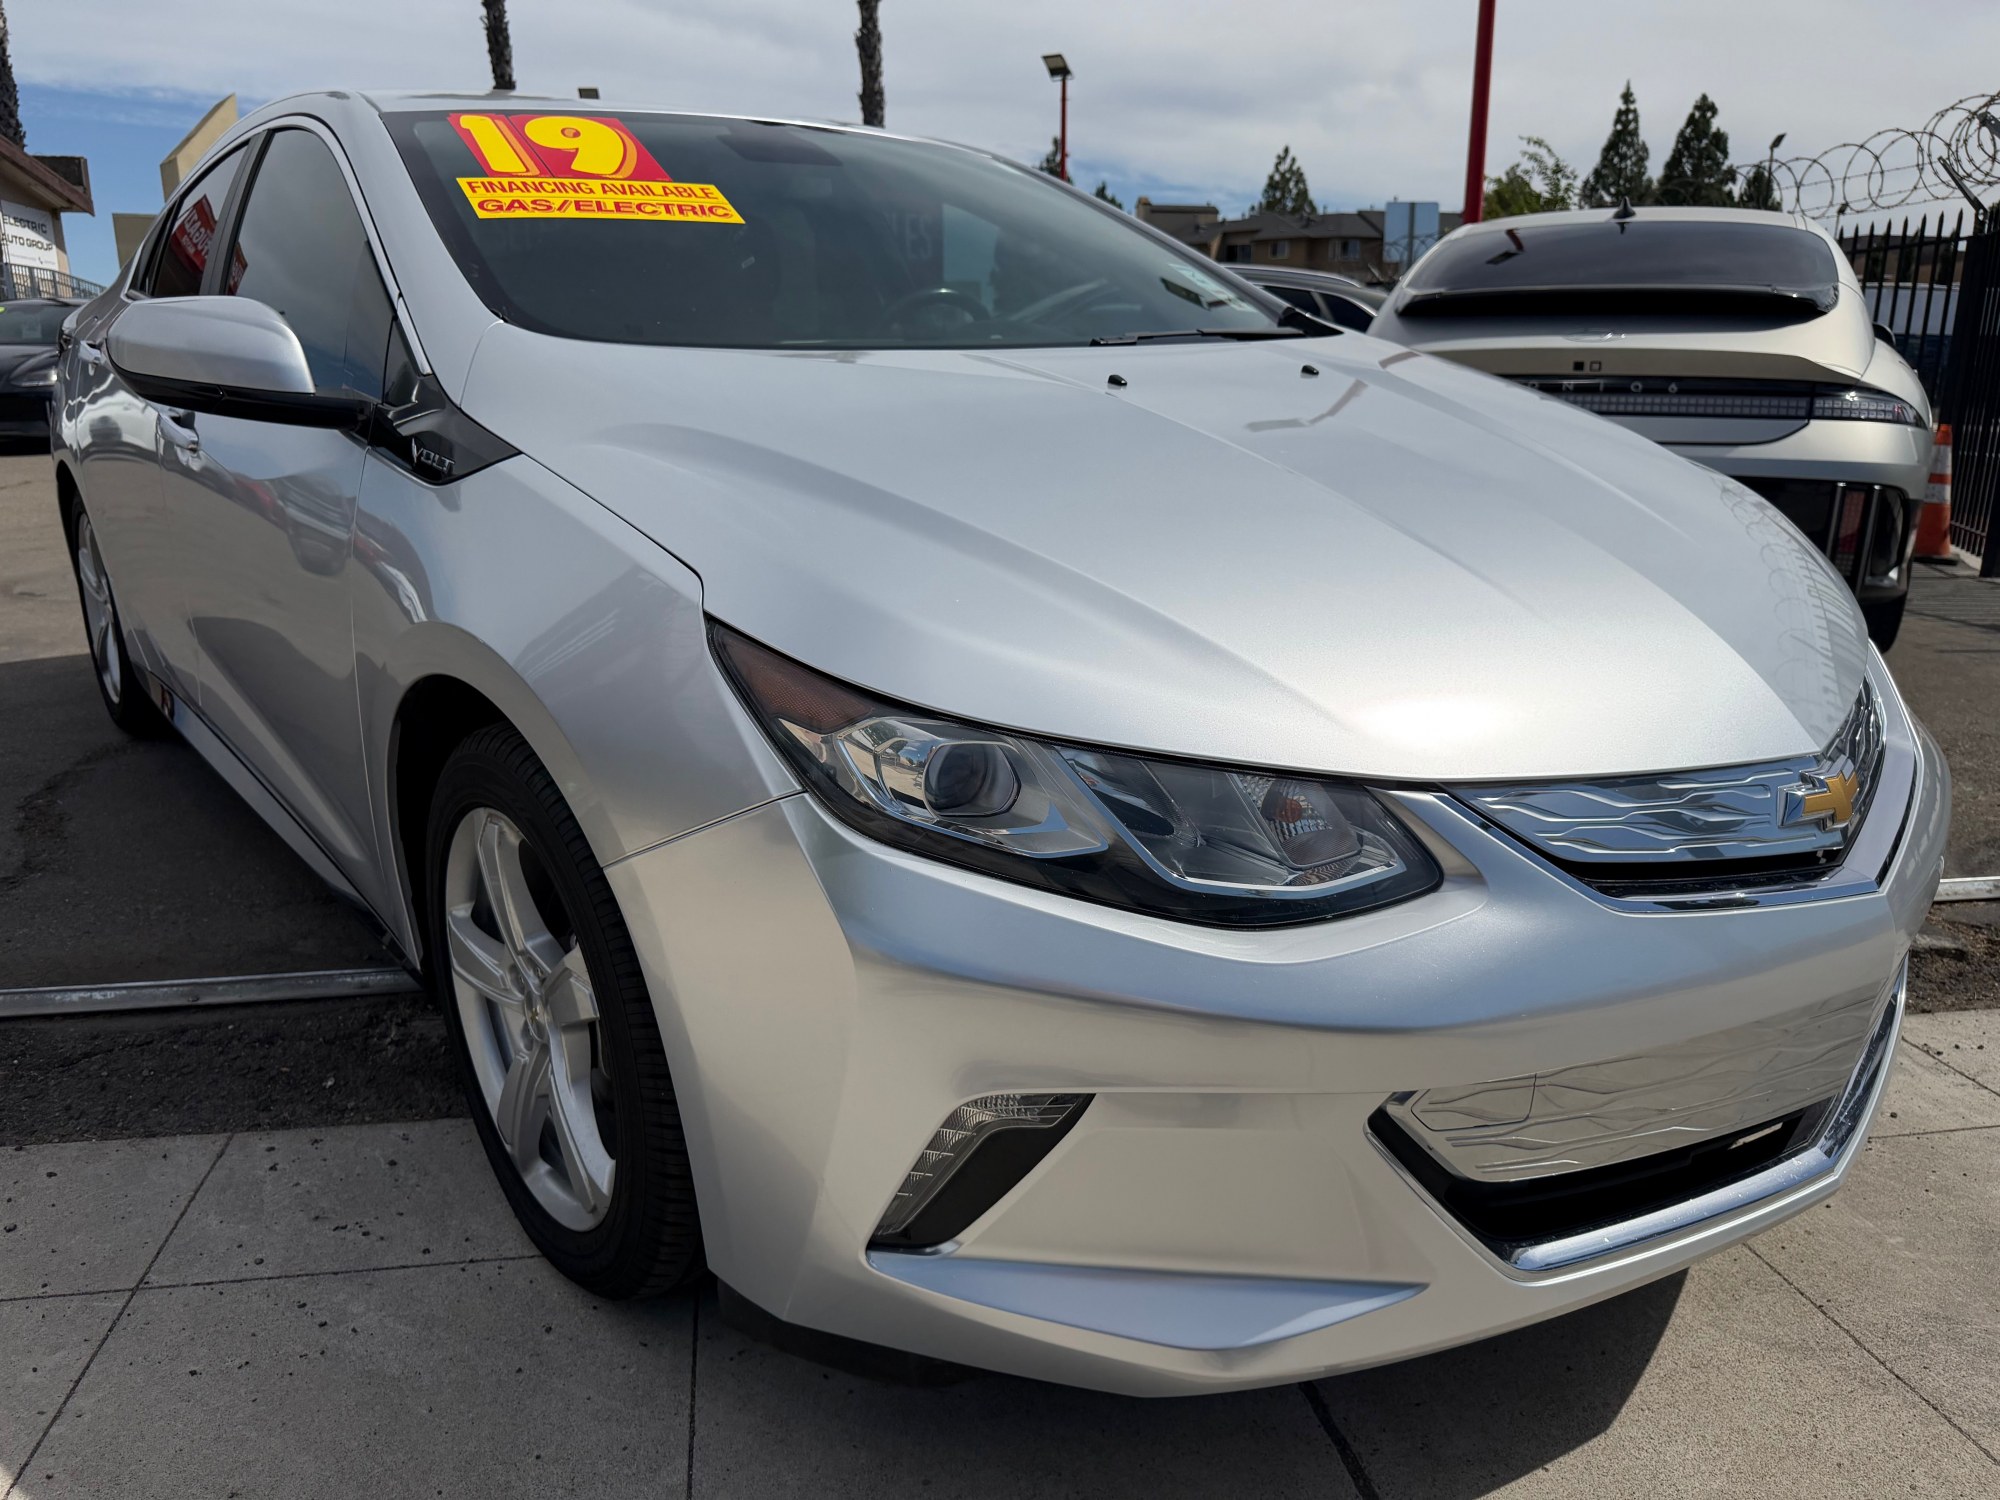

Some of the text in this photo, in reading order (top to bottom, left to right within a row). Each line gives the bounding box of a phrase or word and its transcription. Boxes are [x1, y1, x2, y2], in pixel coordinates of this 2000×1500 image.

[460, 115, 637, 177] 19
[466, 181, 719, 200] FINANCING AVAILABLE
[477, 199, 734, 218] GAS/ELECTRIC
[3, 214, 48, 234] ELECTRIC
[26, 238, 54, 251] GROUP
[1527, 380, 1678, 394] ONIQ 6
[411, 437, 455, 472] VOLT
